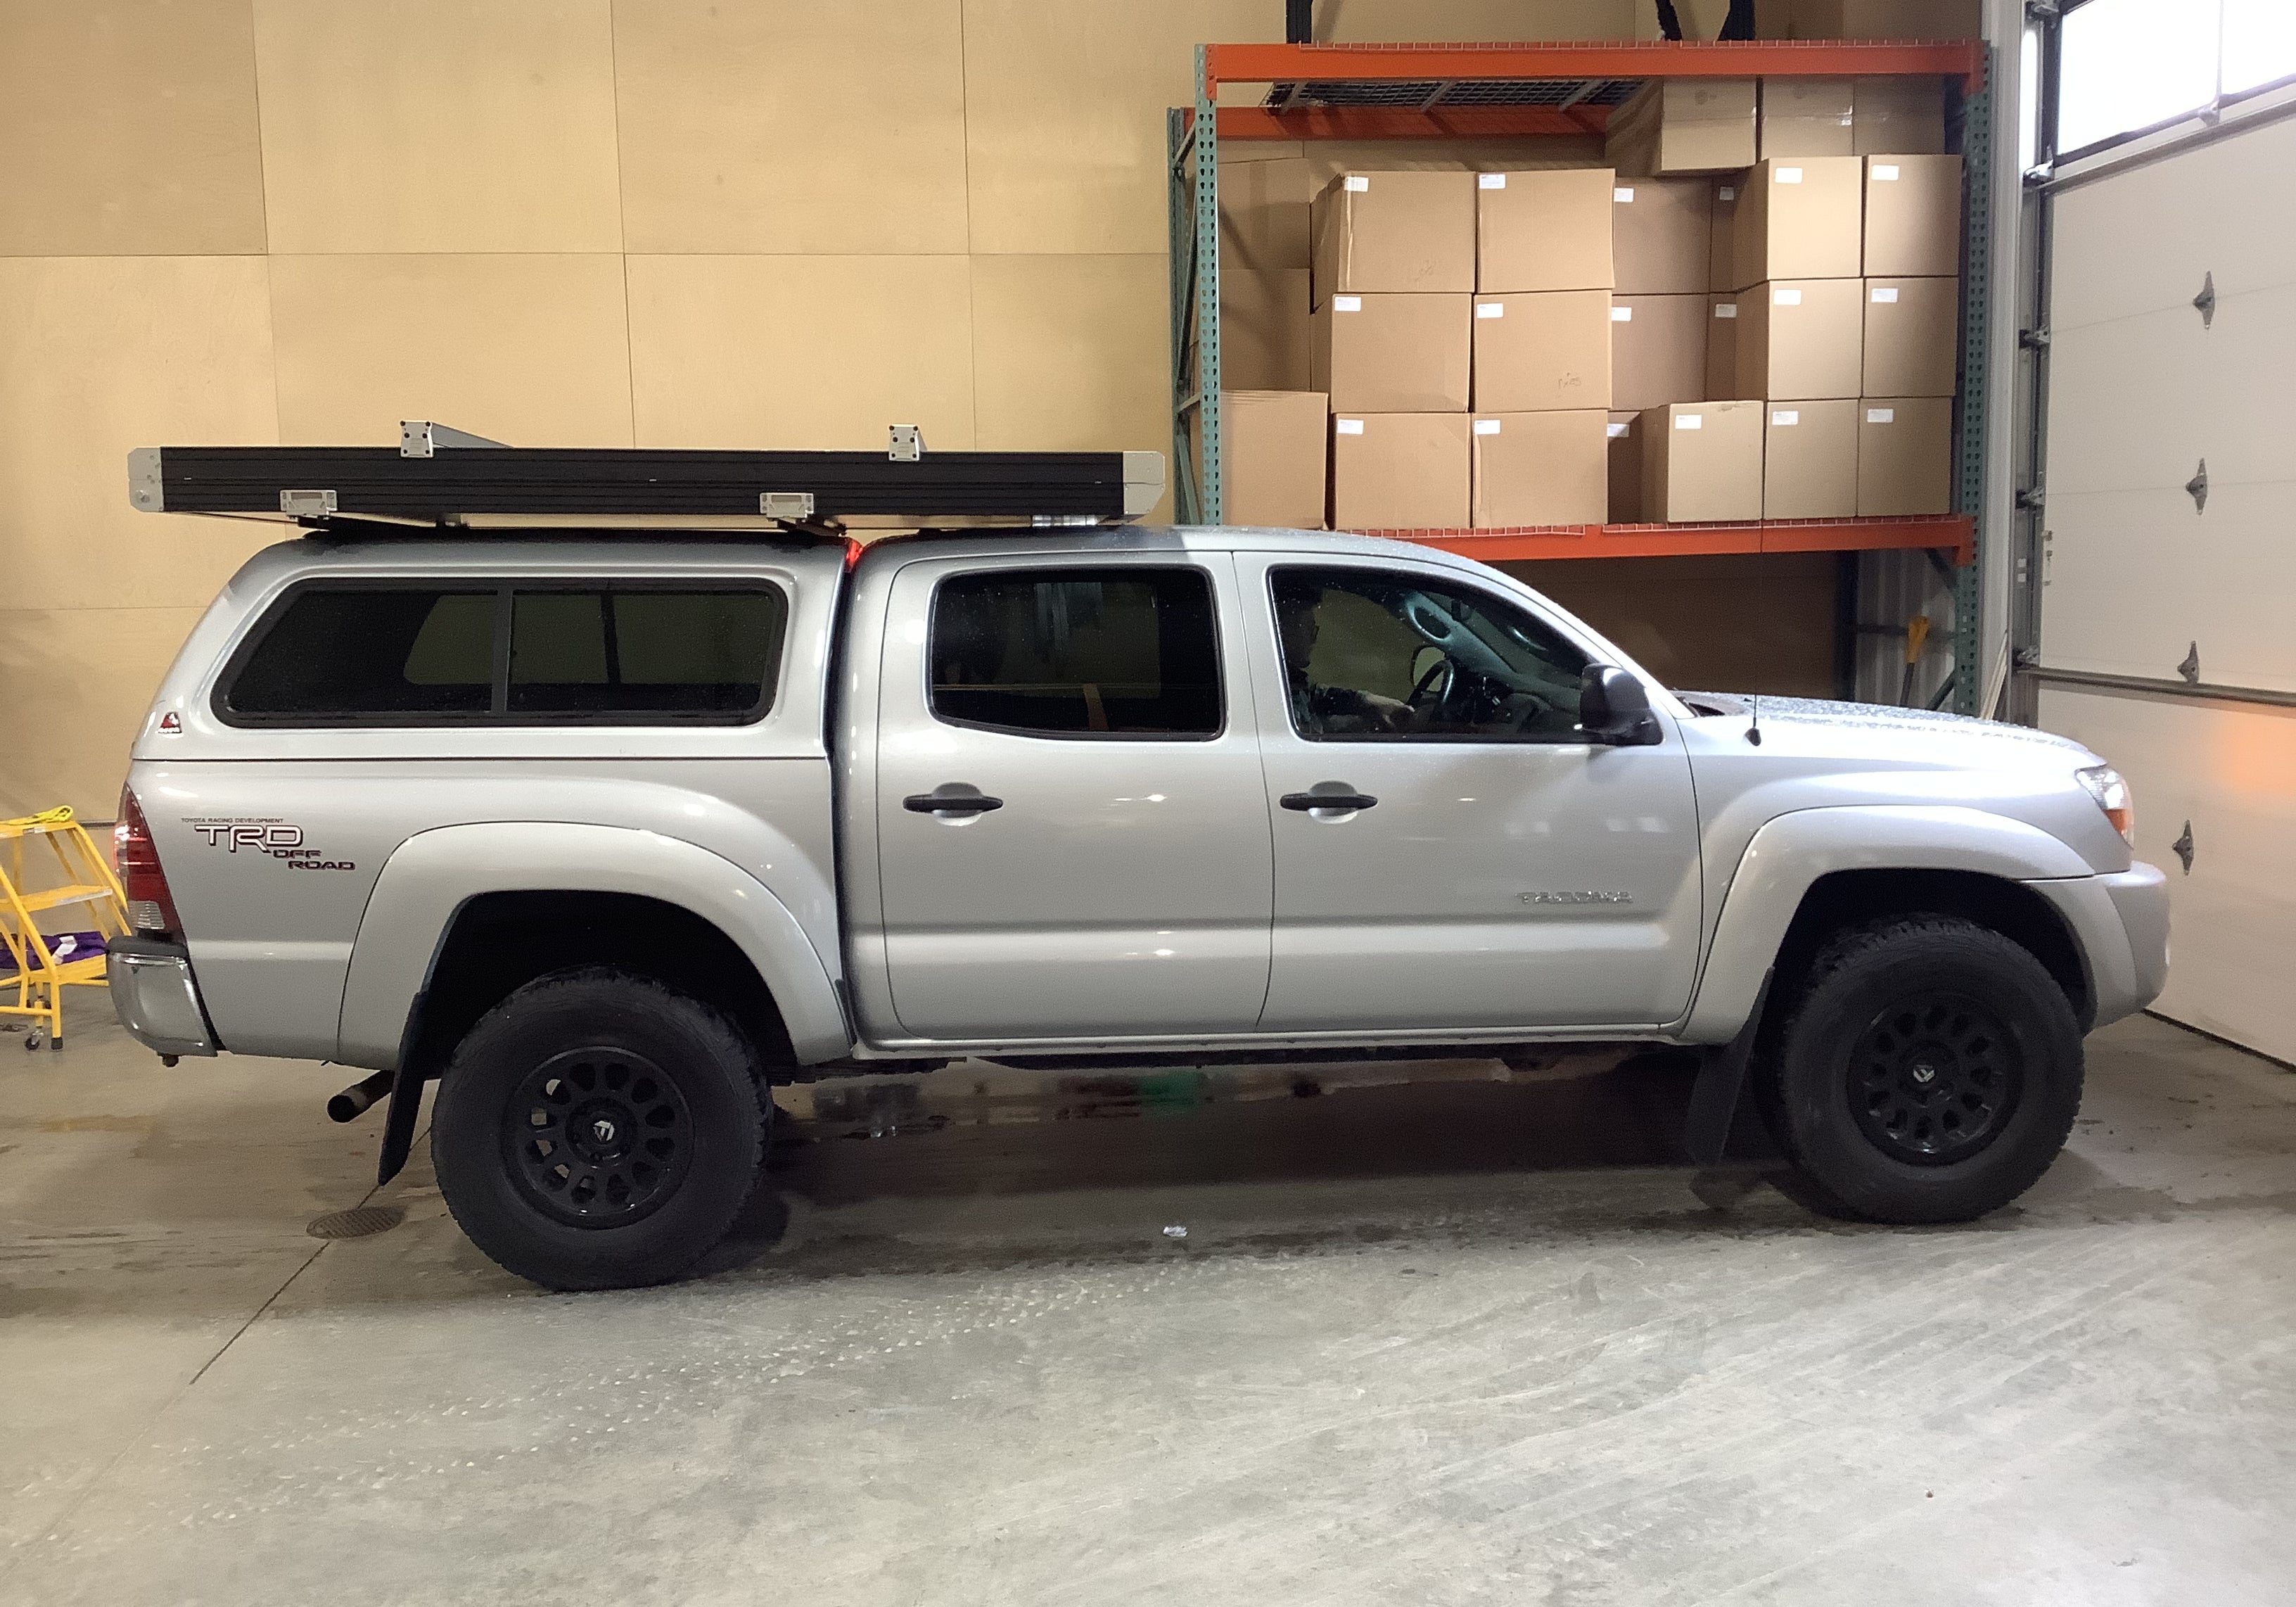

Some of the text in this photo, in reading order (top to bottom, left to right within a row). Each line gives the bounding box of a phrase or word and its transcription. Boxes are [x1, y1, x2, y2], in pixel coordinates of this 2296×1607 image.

[194, 825, 303, 853] TRD
[272, 849, 322, 859] OFF
[288, 860, 356, 871] ROAD
